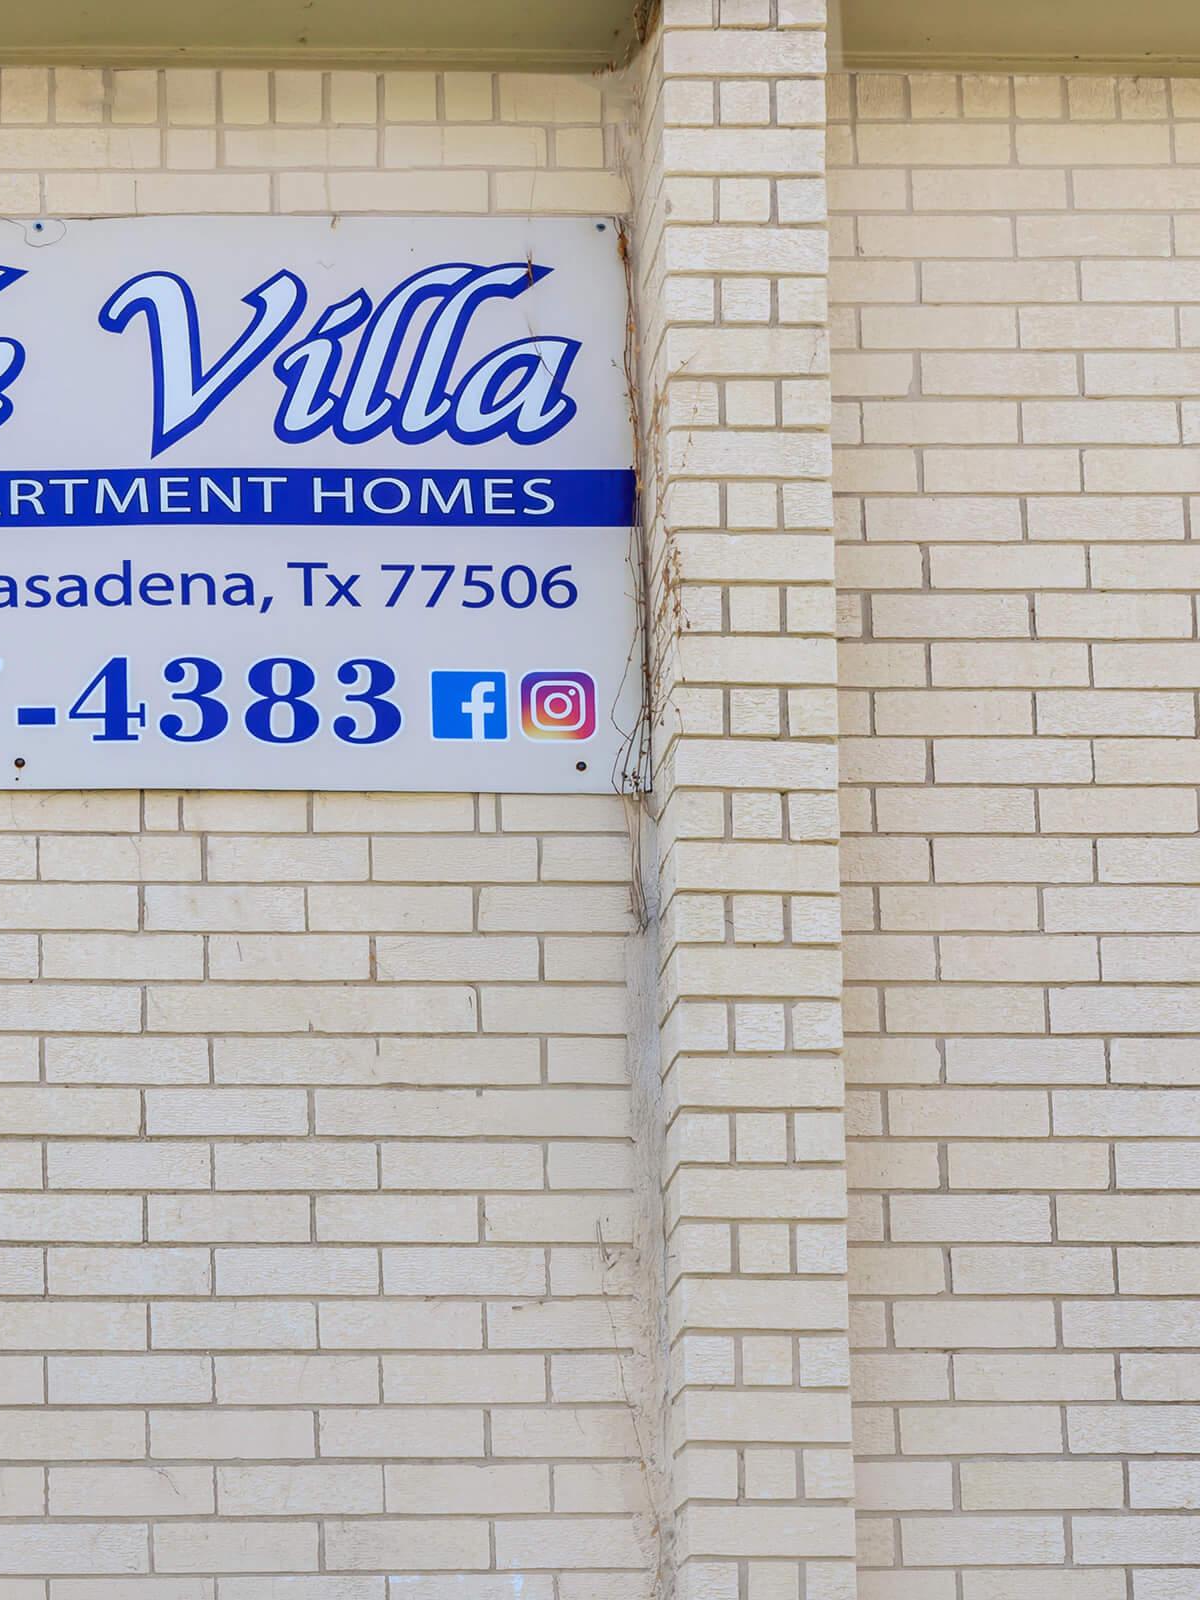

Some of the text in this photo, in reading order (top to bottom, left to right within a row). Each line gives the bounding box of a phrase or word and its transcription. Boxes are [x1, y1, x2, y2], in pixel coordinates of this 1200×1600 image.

[98, 262, 583, 460] Villa
[312, 477, 556, 516] HOMES
[286, 562, 362, 608] Tx
[380, 564, 579, 610] 77506
